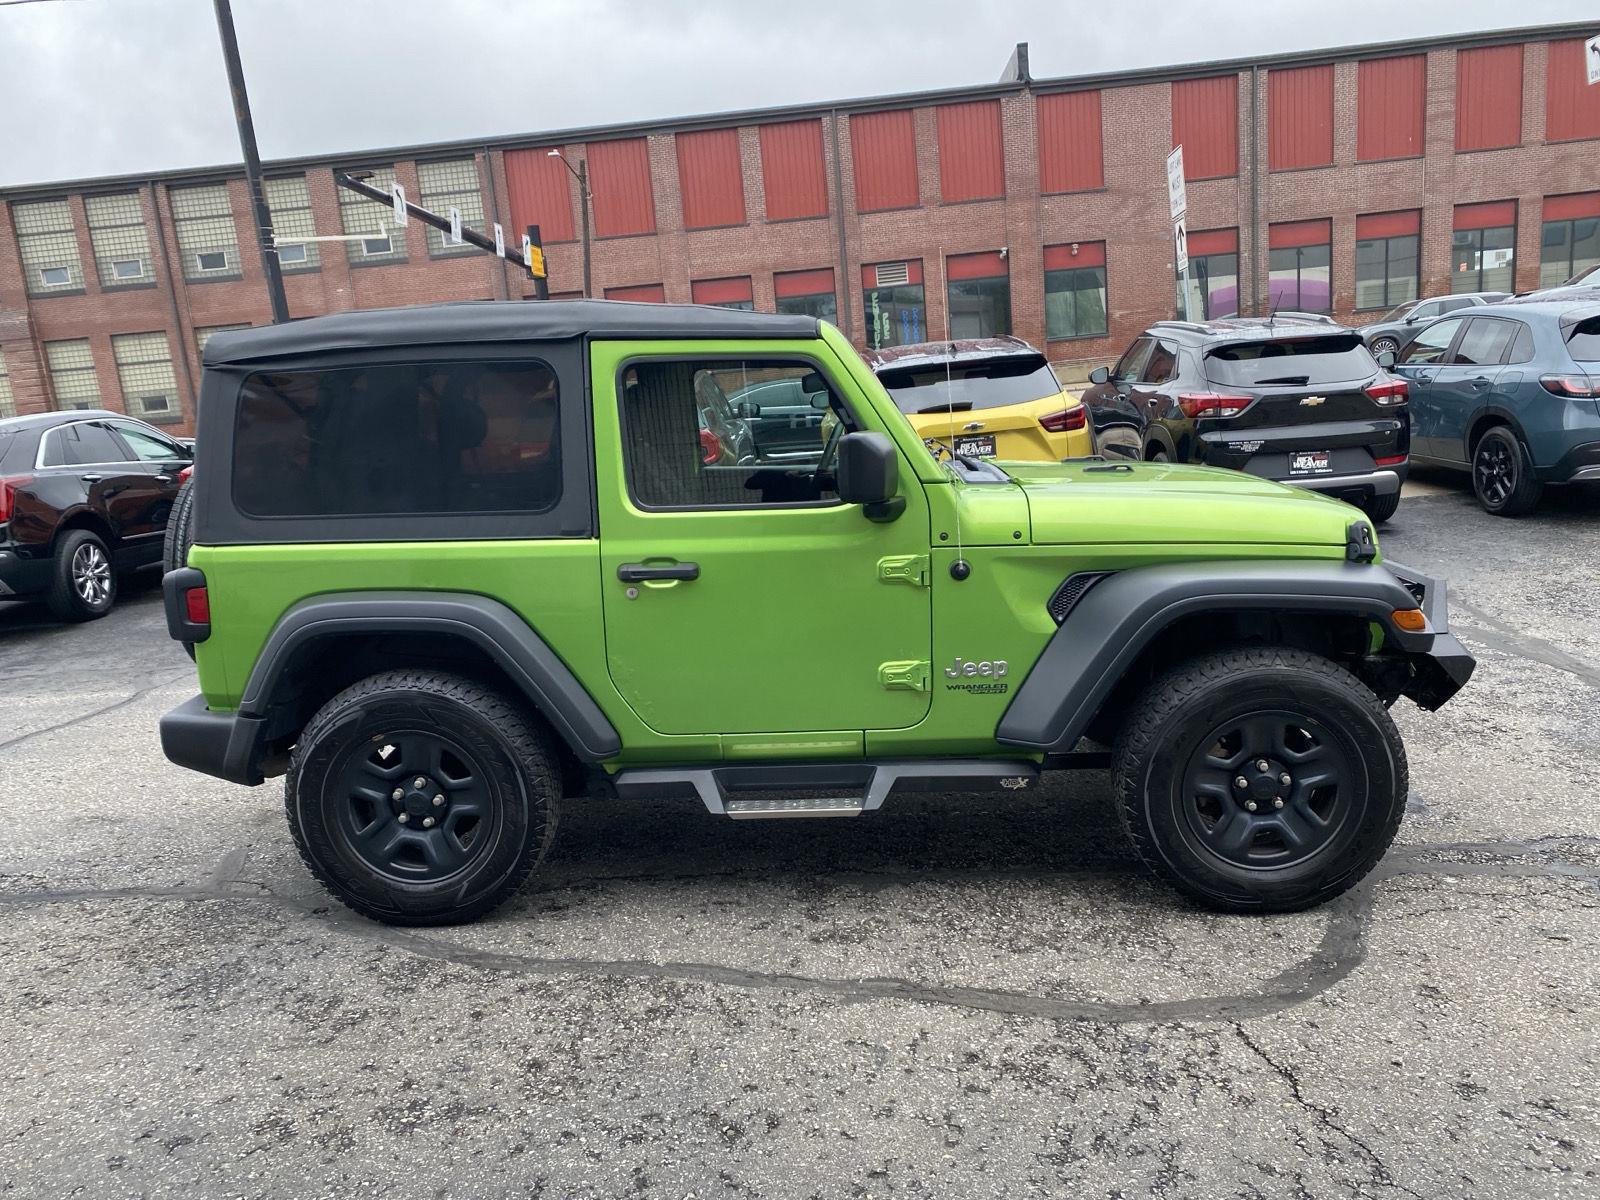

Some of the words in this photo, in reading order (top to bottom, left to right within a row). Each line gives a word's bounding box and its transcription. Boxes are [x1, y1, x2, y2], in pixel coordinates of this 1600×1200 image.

[1293, 459, 1328, 468] WEAVER
[945, 657, 1008, 680] Jeep
[945, 683, 1009, 691] WRANGLER
